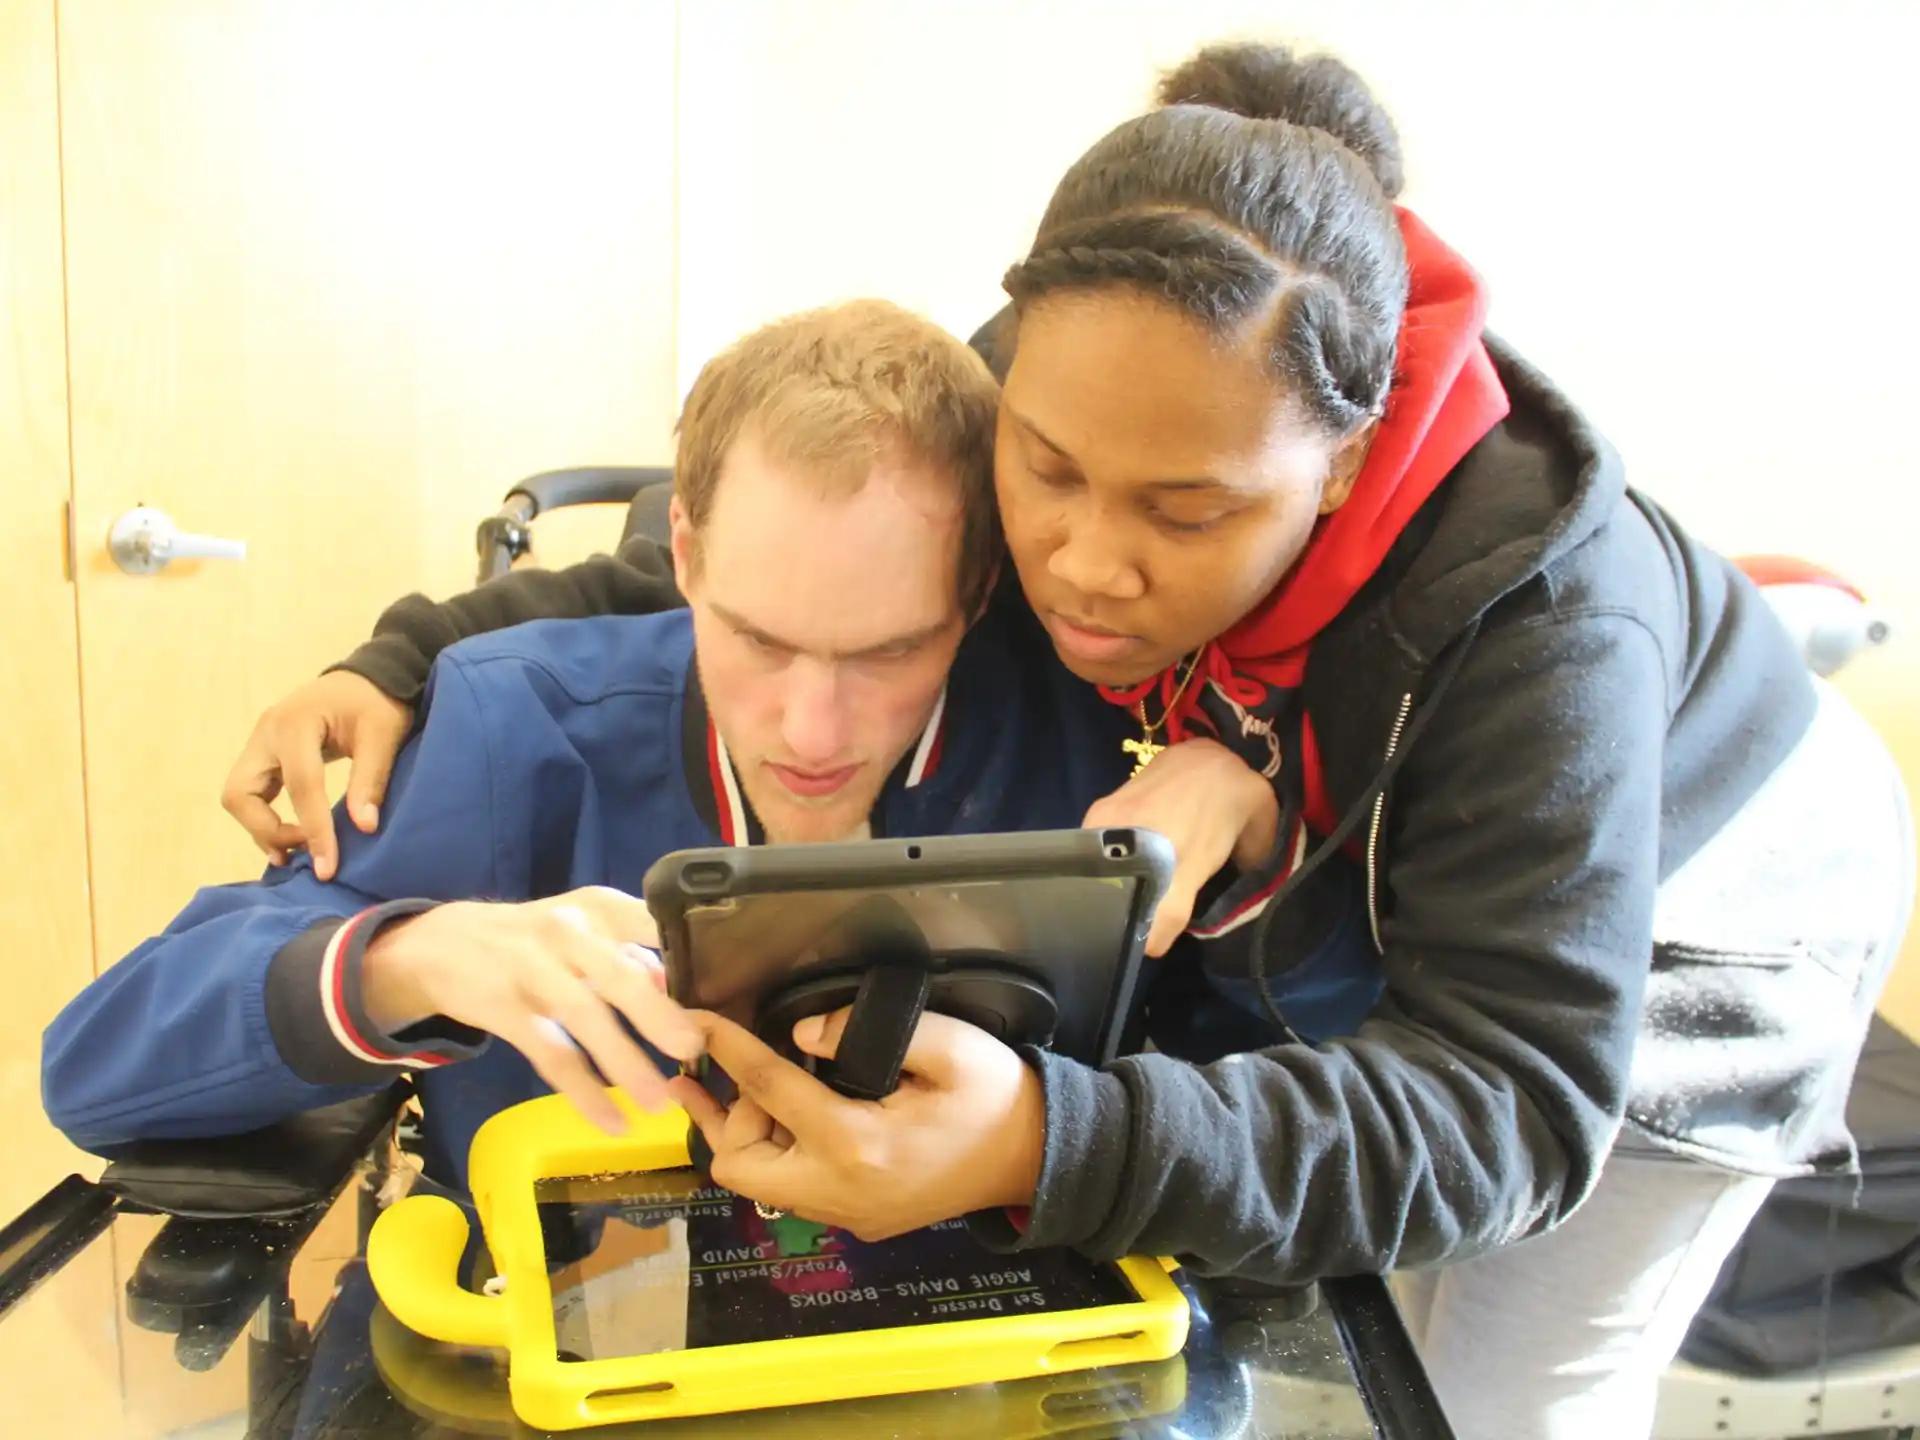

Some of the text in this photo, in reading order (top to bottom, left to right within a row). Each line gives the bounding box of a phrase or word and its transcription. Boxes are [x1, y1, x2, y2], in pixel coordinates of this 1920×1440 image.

[701, 1246, 764, 1263] DAVID
[968, 1269, 1031, 1289] AGGIE
[930, 1291, 1046, 1315] Set Dresser
